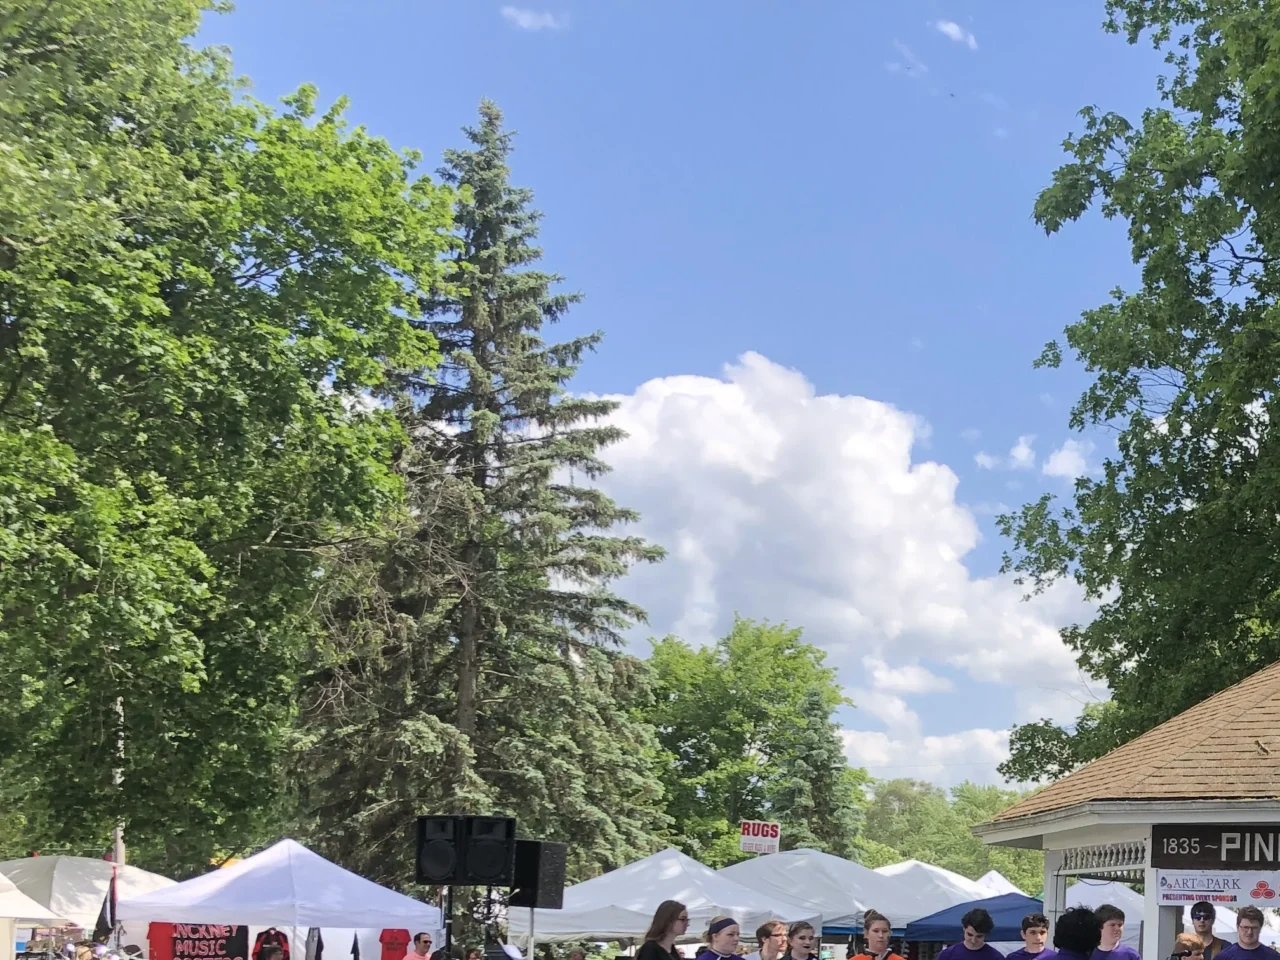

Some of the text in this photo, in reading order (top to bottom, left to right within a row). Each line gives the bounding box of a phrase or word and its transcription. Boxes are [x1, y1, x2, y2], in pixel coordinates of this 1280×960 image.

[741, 821, 779, 838] RUGS
[1162, 838, 1200, 854] 1835
[1173, 878, 1198, 889] ART
[1206, 878, 1242, 890] PARK
[1162, 893, 1195, 901] PRESENTING
[175, 940, 227, 956] MUSIC
